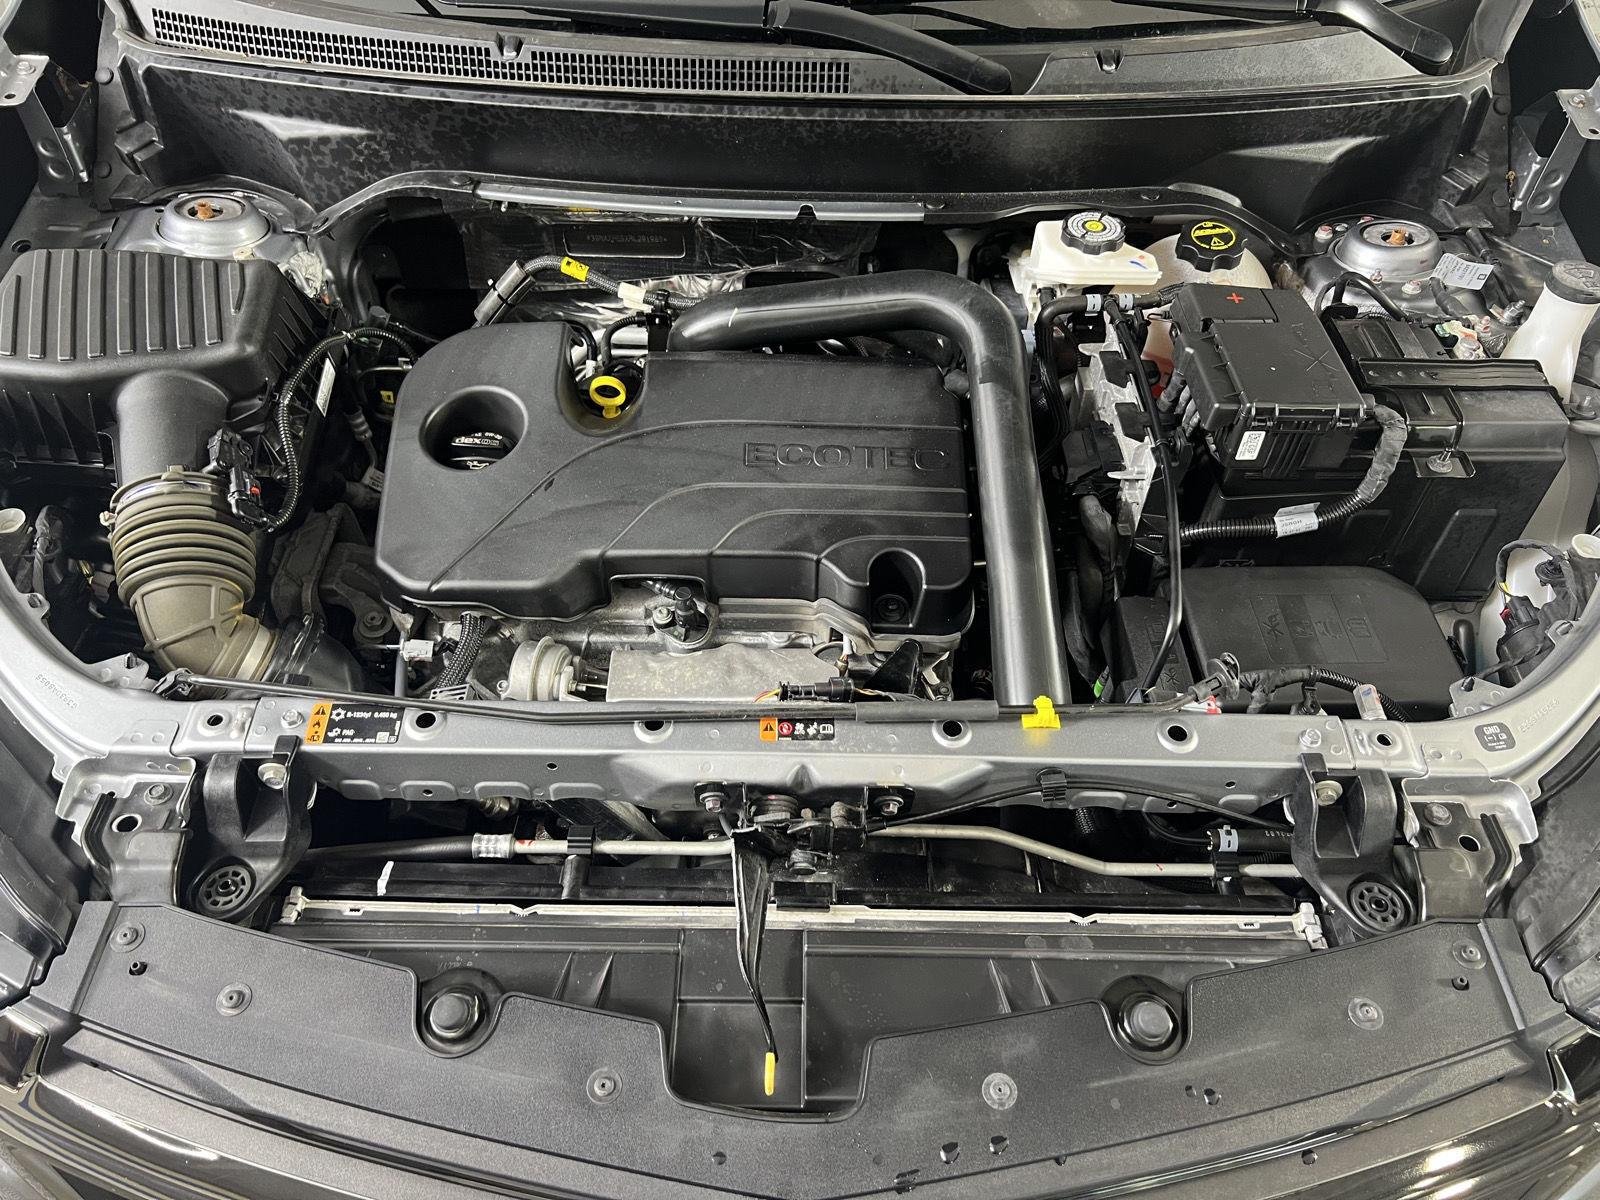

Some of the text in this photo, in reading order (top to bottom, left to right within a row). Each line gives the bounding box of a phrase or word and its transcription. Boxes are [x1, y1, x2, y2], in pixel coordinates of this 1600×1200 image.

[456, 436, 499, 446] dexos
[744, 443, 949, 471] ECOTEC
[1483, 725, 1500, 735] GND
